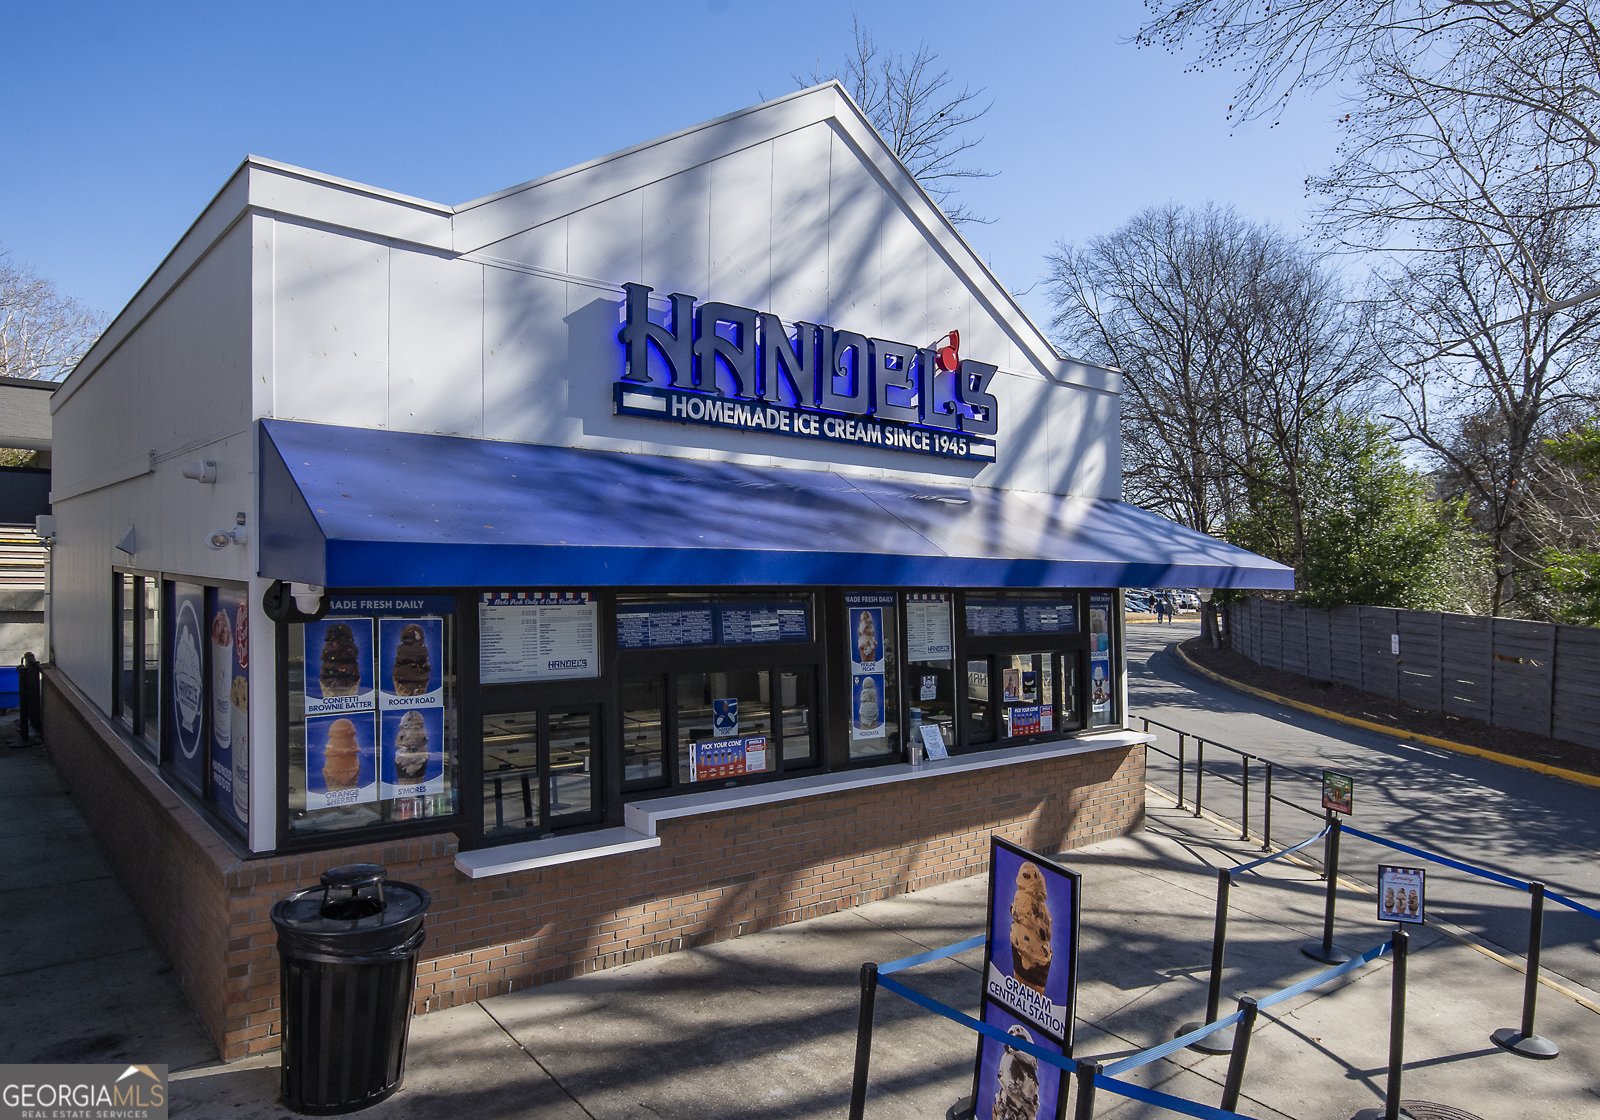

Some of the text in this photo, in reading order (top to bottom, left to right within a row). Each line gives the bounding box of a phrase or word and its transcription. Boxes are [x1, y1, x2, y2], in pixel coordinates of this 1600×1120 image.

[618, 282, 999, 435] HANDEL'S
[672, 394, 967, 456] HOMEMADE ICE CREAM SINCE 1945
[360, 600, 392, 610] FRESH
[395, 600, 424, 610] DAILY
[548, 659, 588, 669] HANDEL'S
[322, 696, 359, 705] CONFETTI
[388, 697, 435, 706] ROCKY ROAD
[308, 701, 372, 712] BROWNIE BATTER
[714, 741, 727, 749] YOUR
[325, 789, 359, 799] ORANGE
[398, 786, 427, 795] S'MORES
[326, 795, 358, 806] SHERBET
[1005, 977, 1052, 1014] GRAHAM
[989, 981, 1065, 1036] CENTRAL STATION
